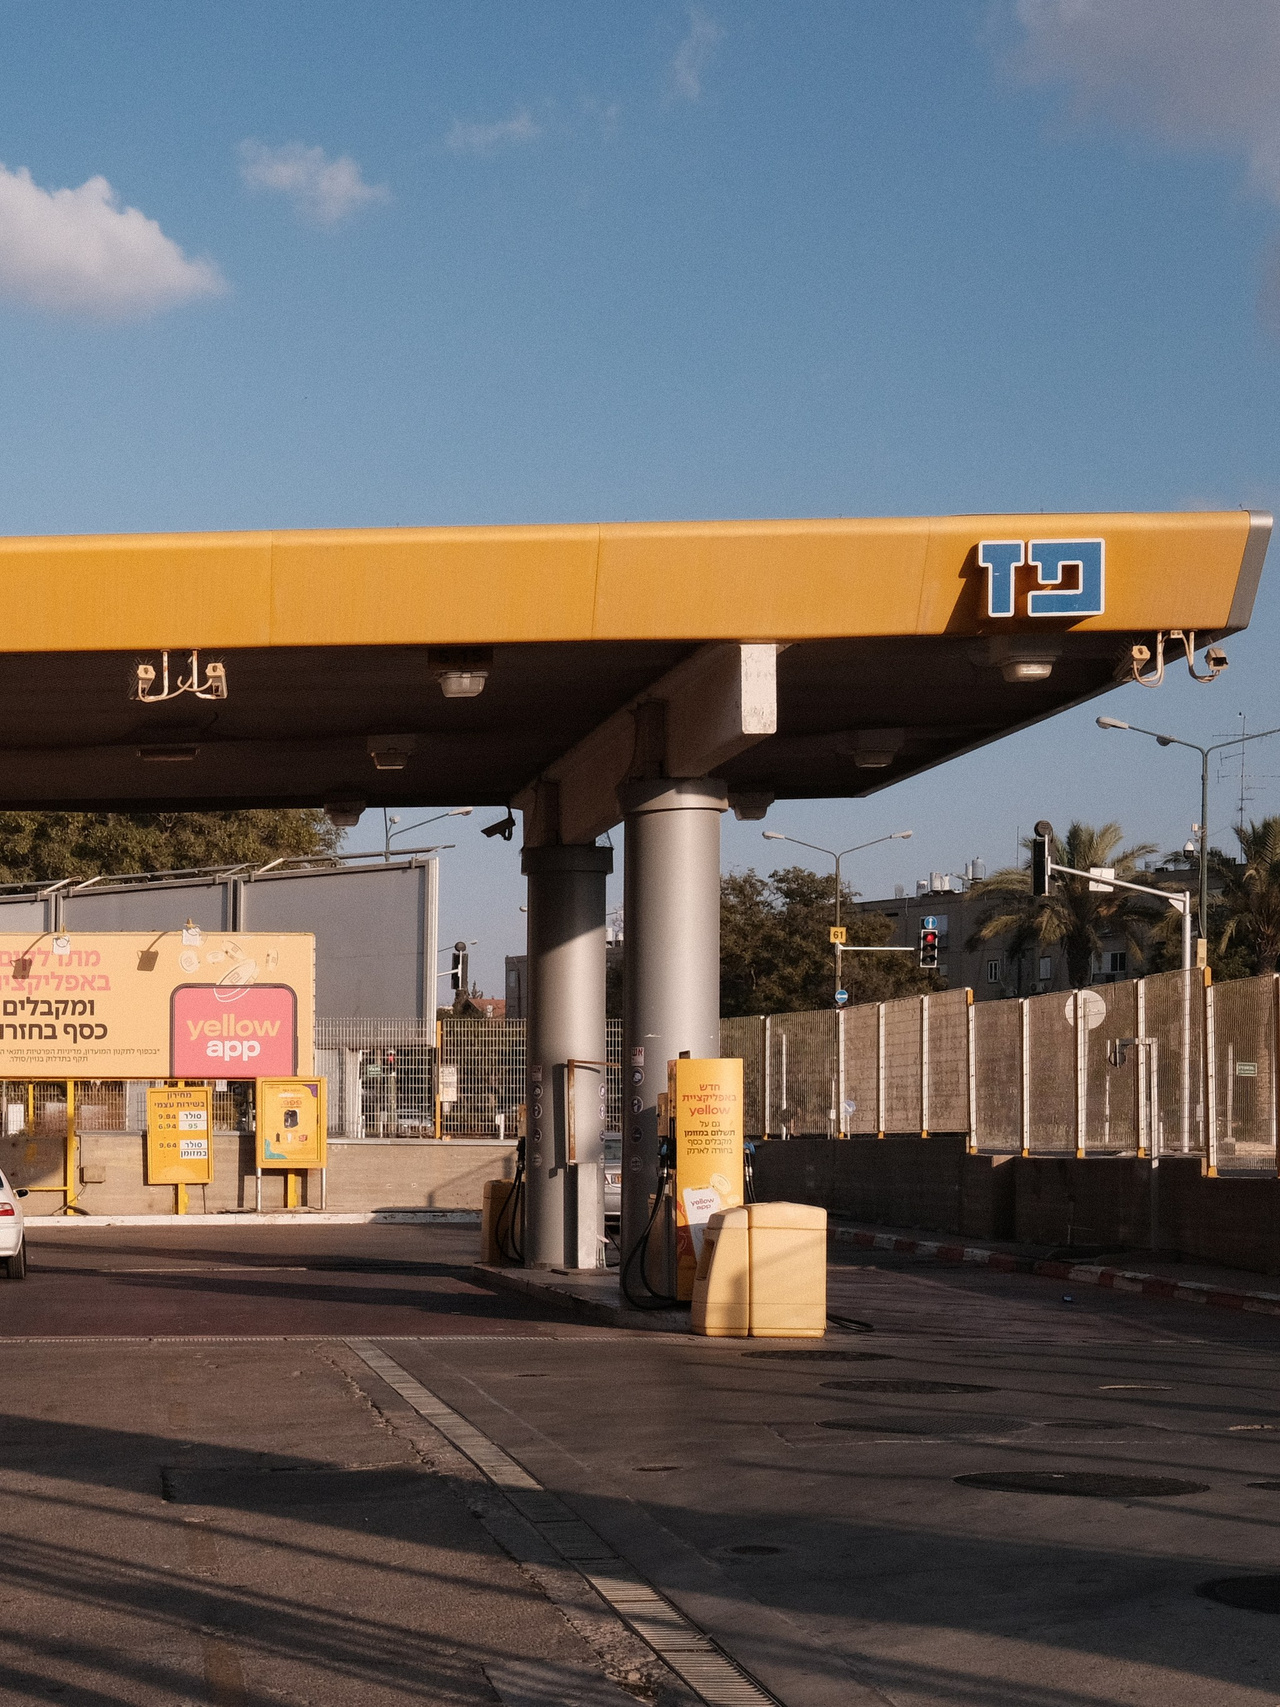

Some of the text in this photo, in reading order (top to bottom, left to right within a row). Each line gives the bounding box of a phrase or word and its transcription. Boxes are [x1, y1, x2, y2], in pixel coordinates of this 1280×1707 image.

[978, 537, 1106, 618] פז
[833, 930, 843, 939] 61
[2, 997, 95, 1020] ומקבלים
[186, 1013, 281, 1040] yellow
[63, 1023, 108, 1044] כסף
[206, 1040, 261, 1061] app
[167, 1092, 192, 1100] מחירון
[682, 1094, 737, 1103] באפליקציית
[689, 1104, 731, 1117] yellow
[684, 1130, 709, 1138] במזומן
[184, 1140, 203, 1148] סולר
[687, 1138, 732, 1147] מקבלים כסף
[180, 1150, 207, 1158] במזומן
[687, 1147, 710, 1155] לארנק
